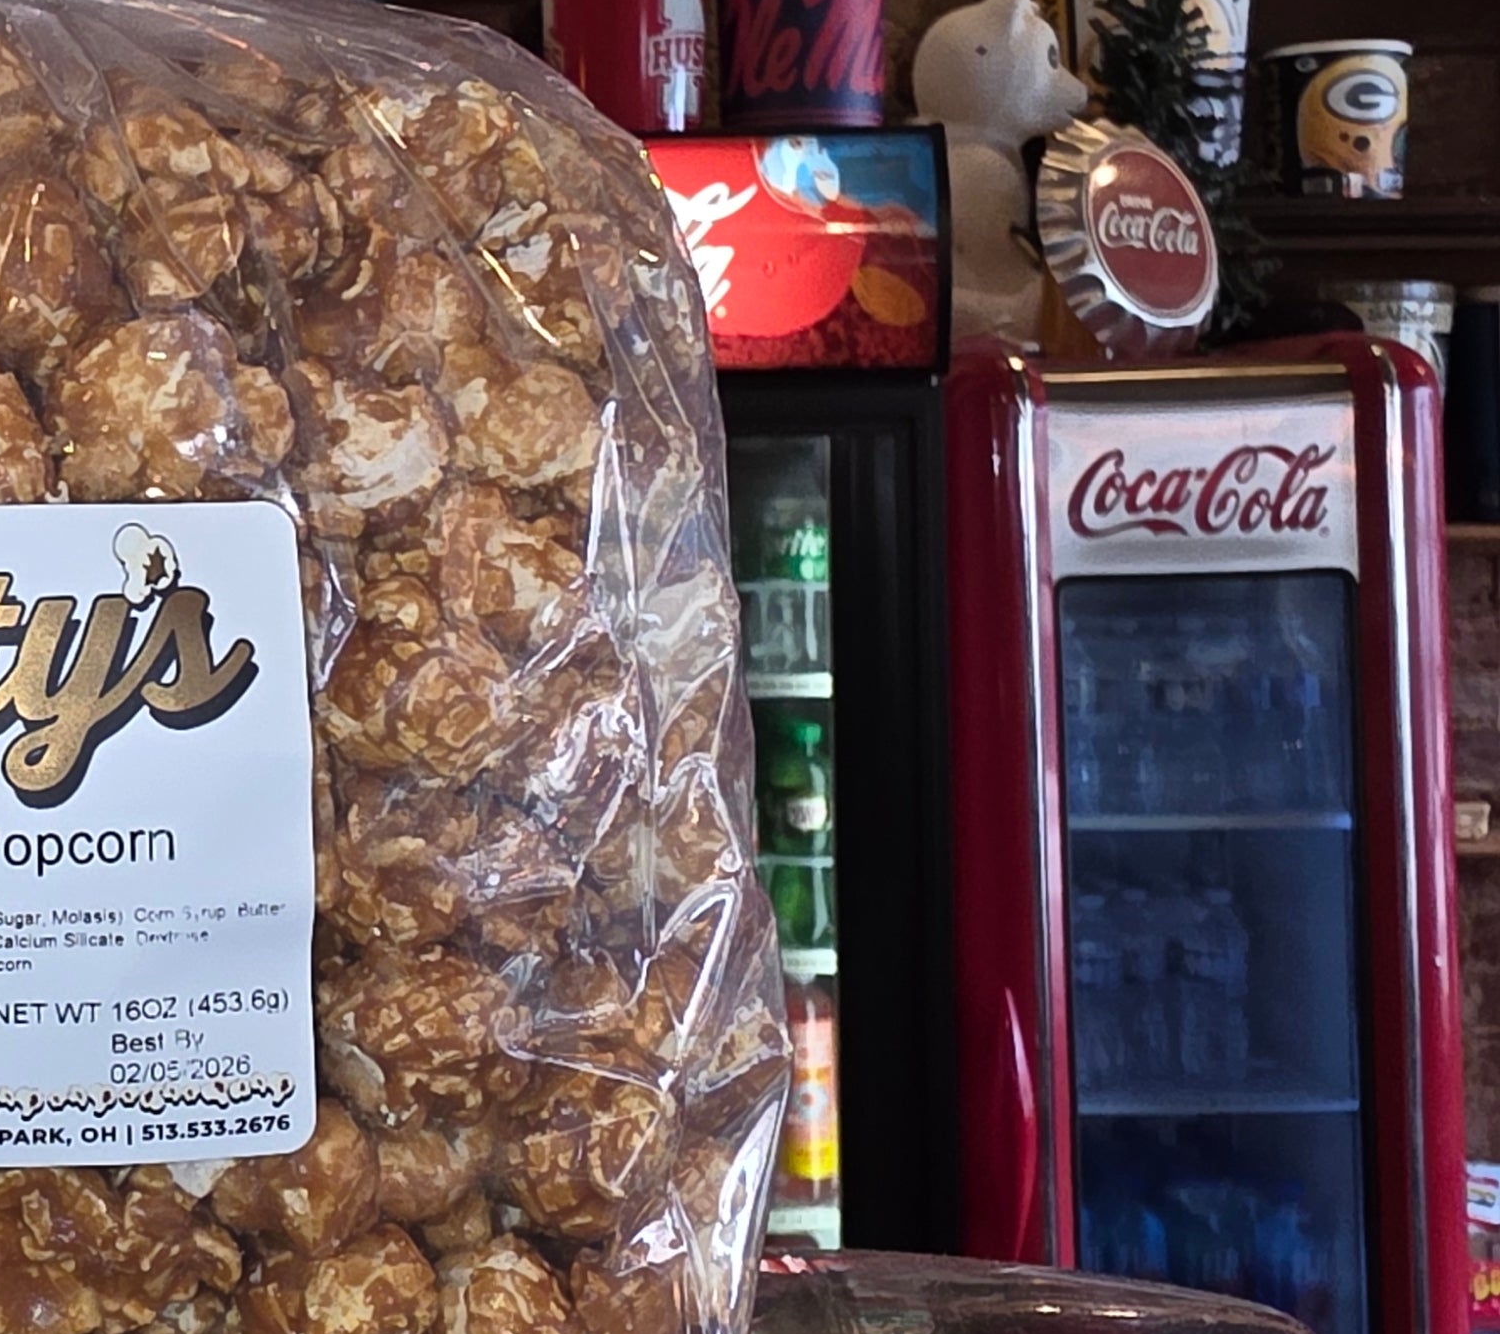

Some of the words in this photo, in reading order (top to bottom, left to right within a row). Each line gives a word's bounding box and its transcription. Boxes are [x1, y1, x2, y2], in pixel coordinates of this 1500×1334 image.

[1098, 201, 1199, 256] Coca-Cola
[1067, 443, 1338, 539] Coca-Cola
[63, 932, 125, 948] Silicate
[54, 1001, 102, 1024] WT
[188, 988, 290, 1019] (453.6g)
[111, 1032, 164, 1054] Best
[80, 1126, 117, 1144] OH
[140, 1114, 292, 1142] 513.533.2676
